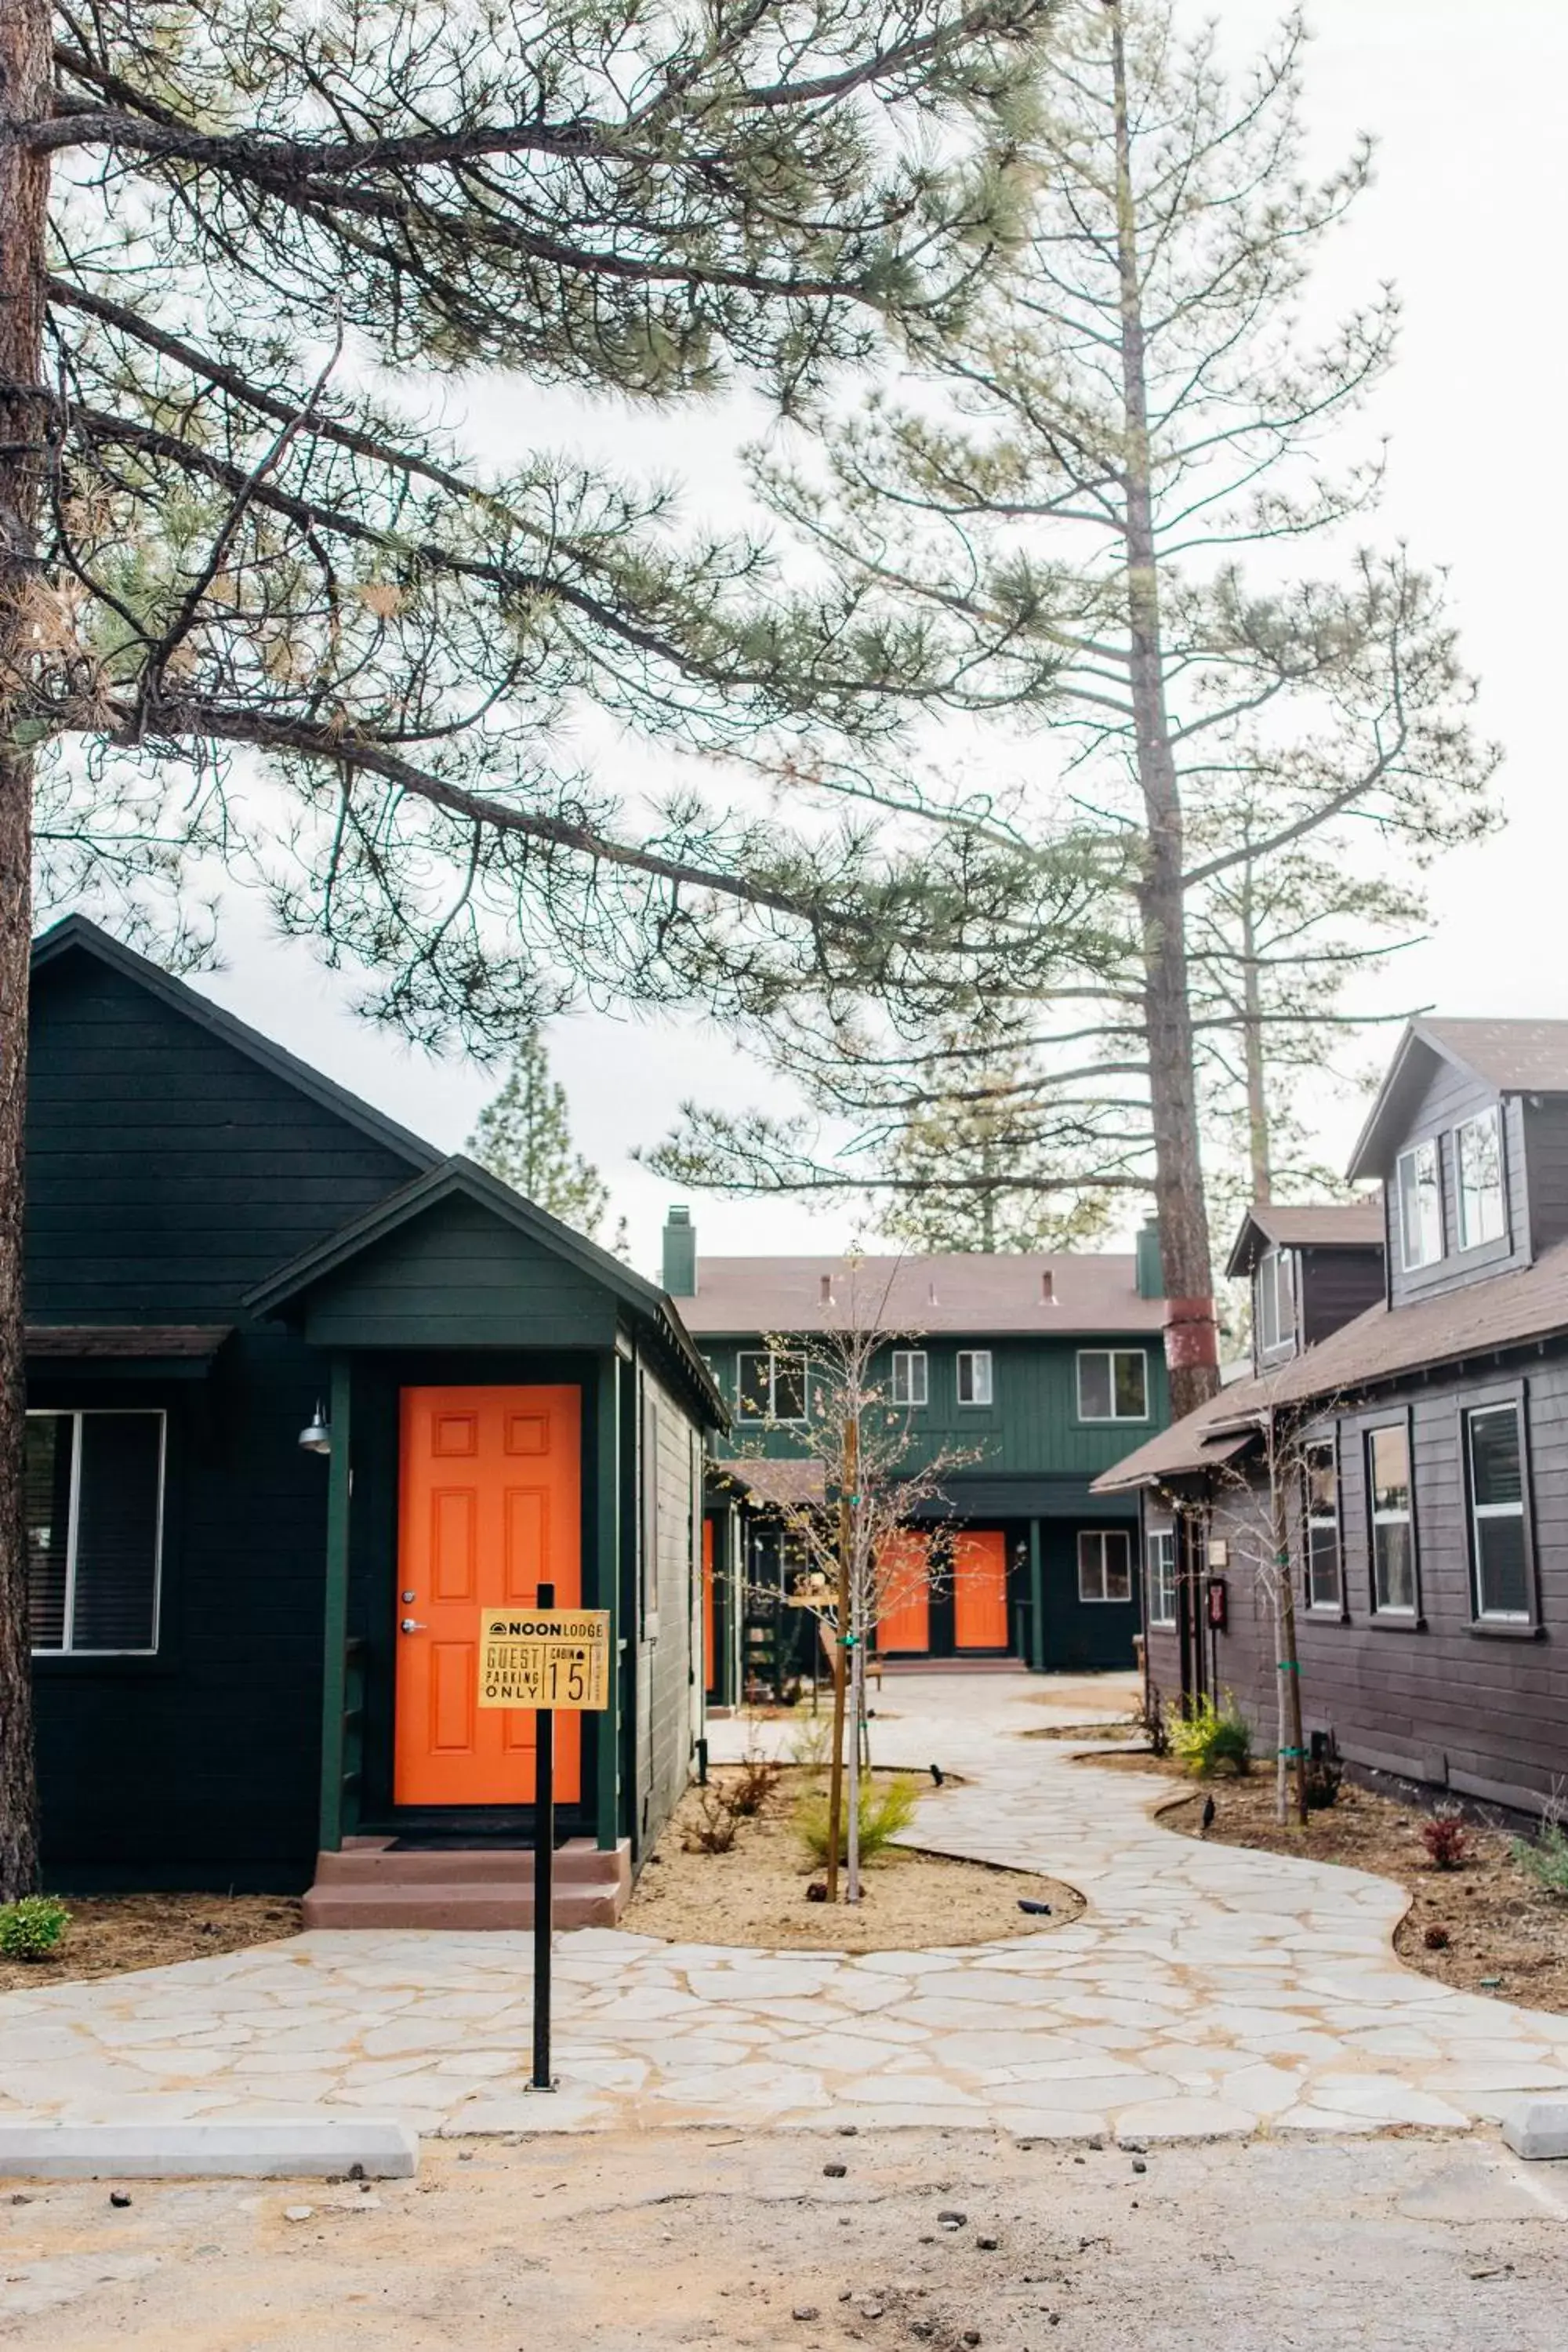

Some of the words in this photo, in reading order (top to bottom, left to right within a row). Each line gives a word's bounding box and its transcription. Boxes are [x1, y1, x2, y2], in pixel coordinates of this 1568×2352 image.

[510, 1622, 561, 1636] NOON
[487, 1648, 539, 1669] GUEST
[551, 1647, 575, 1660] CABIN
[485, 1671, 539, 1685] PARKING
[549, 1662, 584, 1701] 15
[485, 1686, 538, 1699] ONLY
